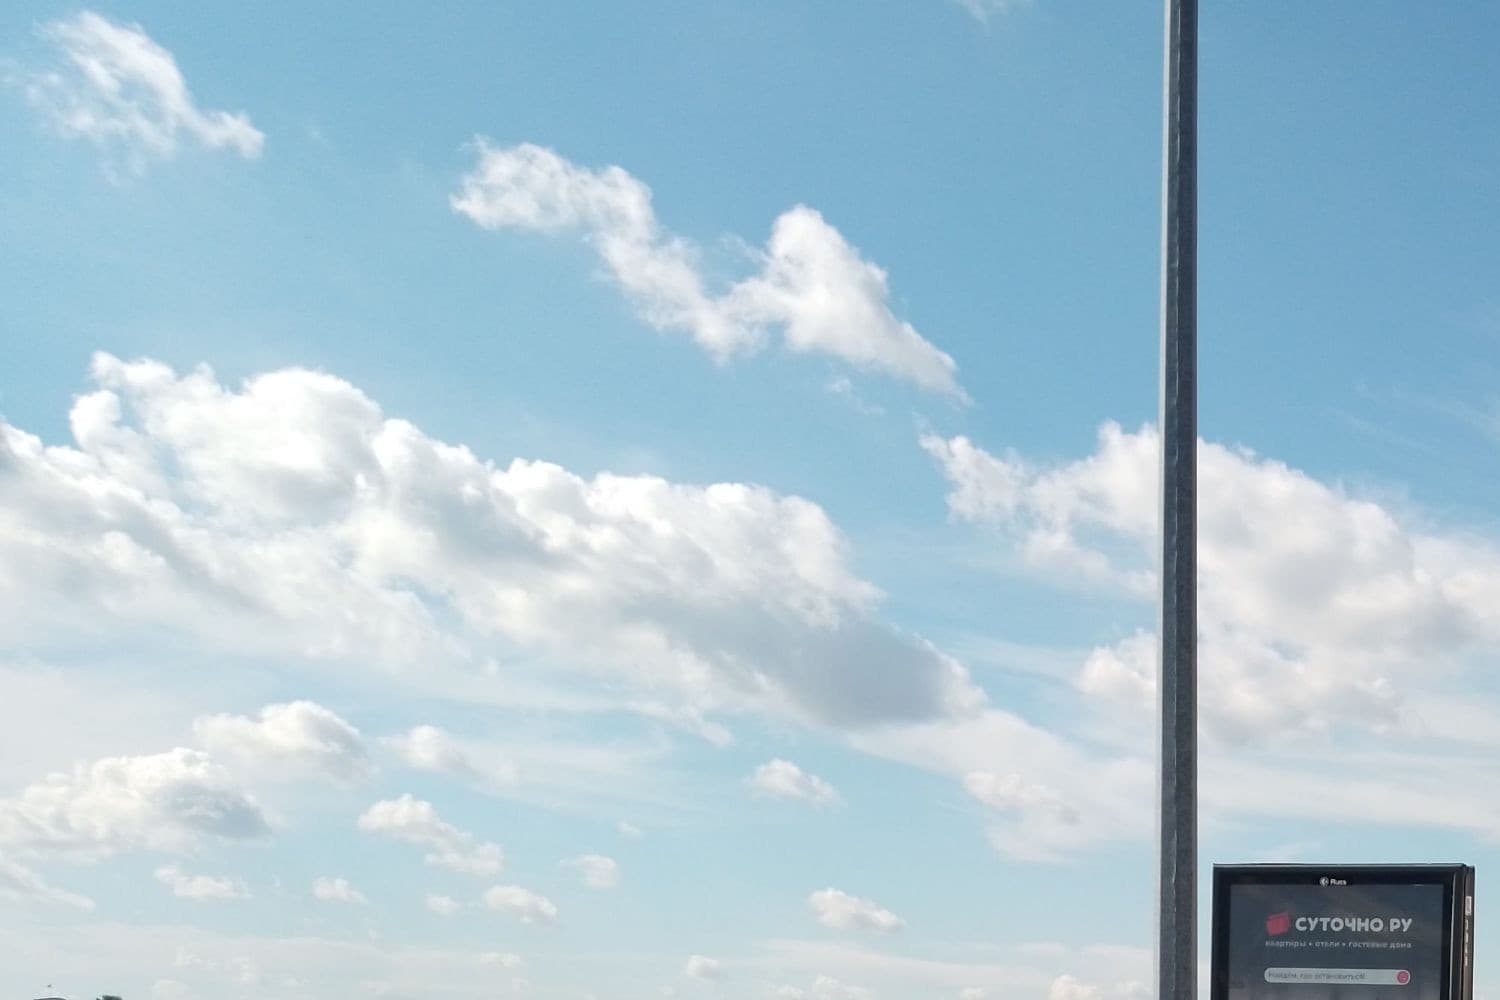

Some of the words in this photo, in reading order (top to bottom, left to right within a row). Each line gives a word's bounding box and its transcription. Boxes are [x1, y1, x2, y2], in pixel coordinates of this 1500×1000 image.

[1295, 917, 1384, 932] СУТОЧНО
[1389, 917, 1413, 932] РУ
[1265, 940, 1306, 949] квартиры
